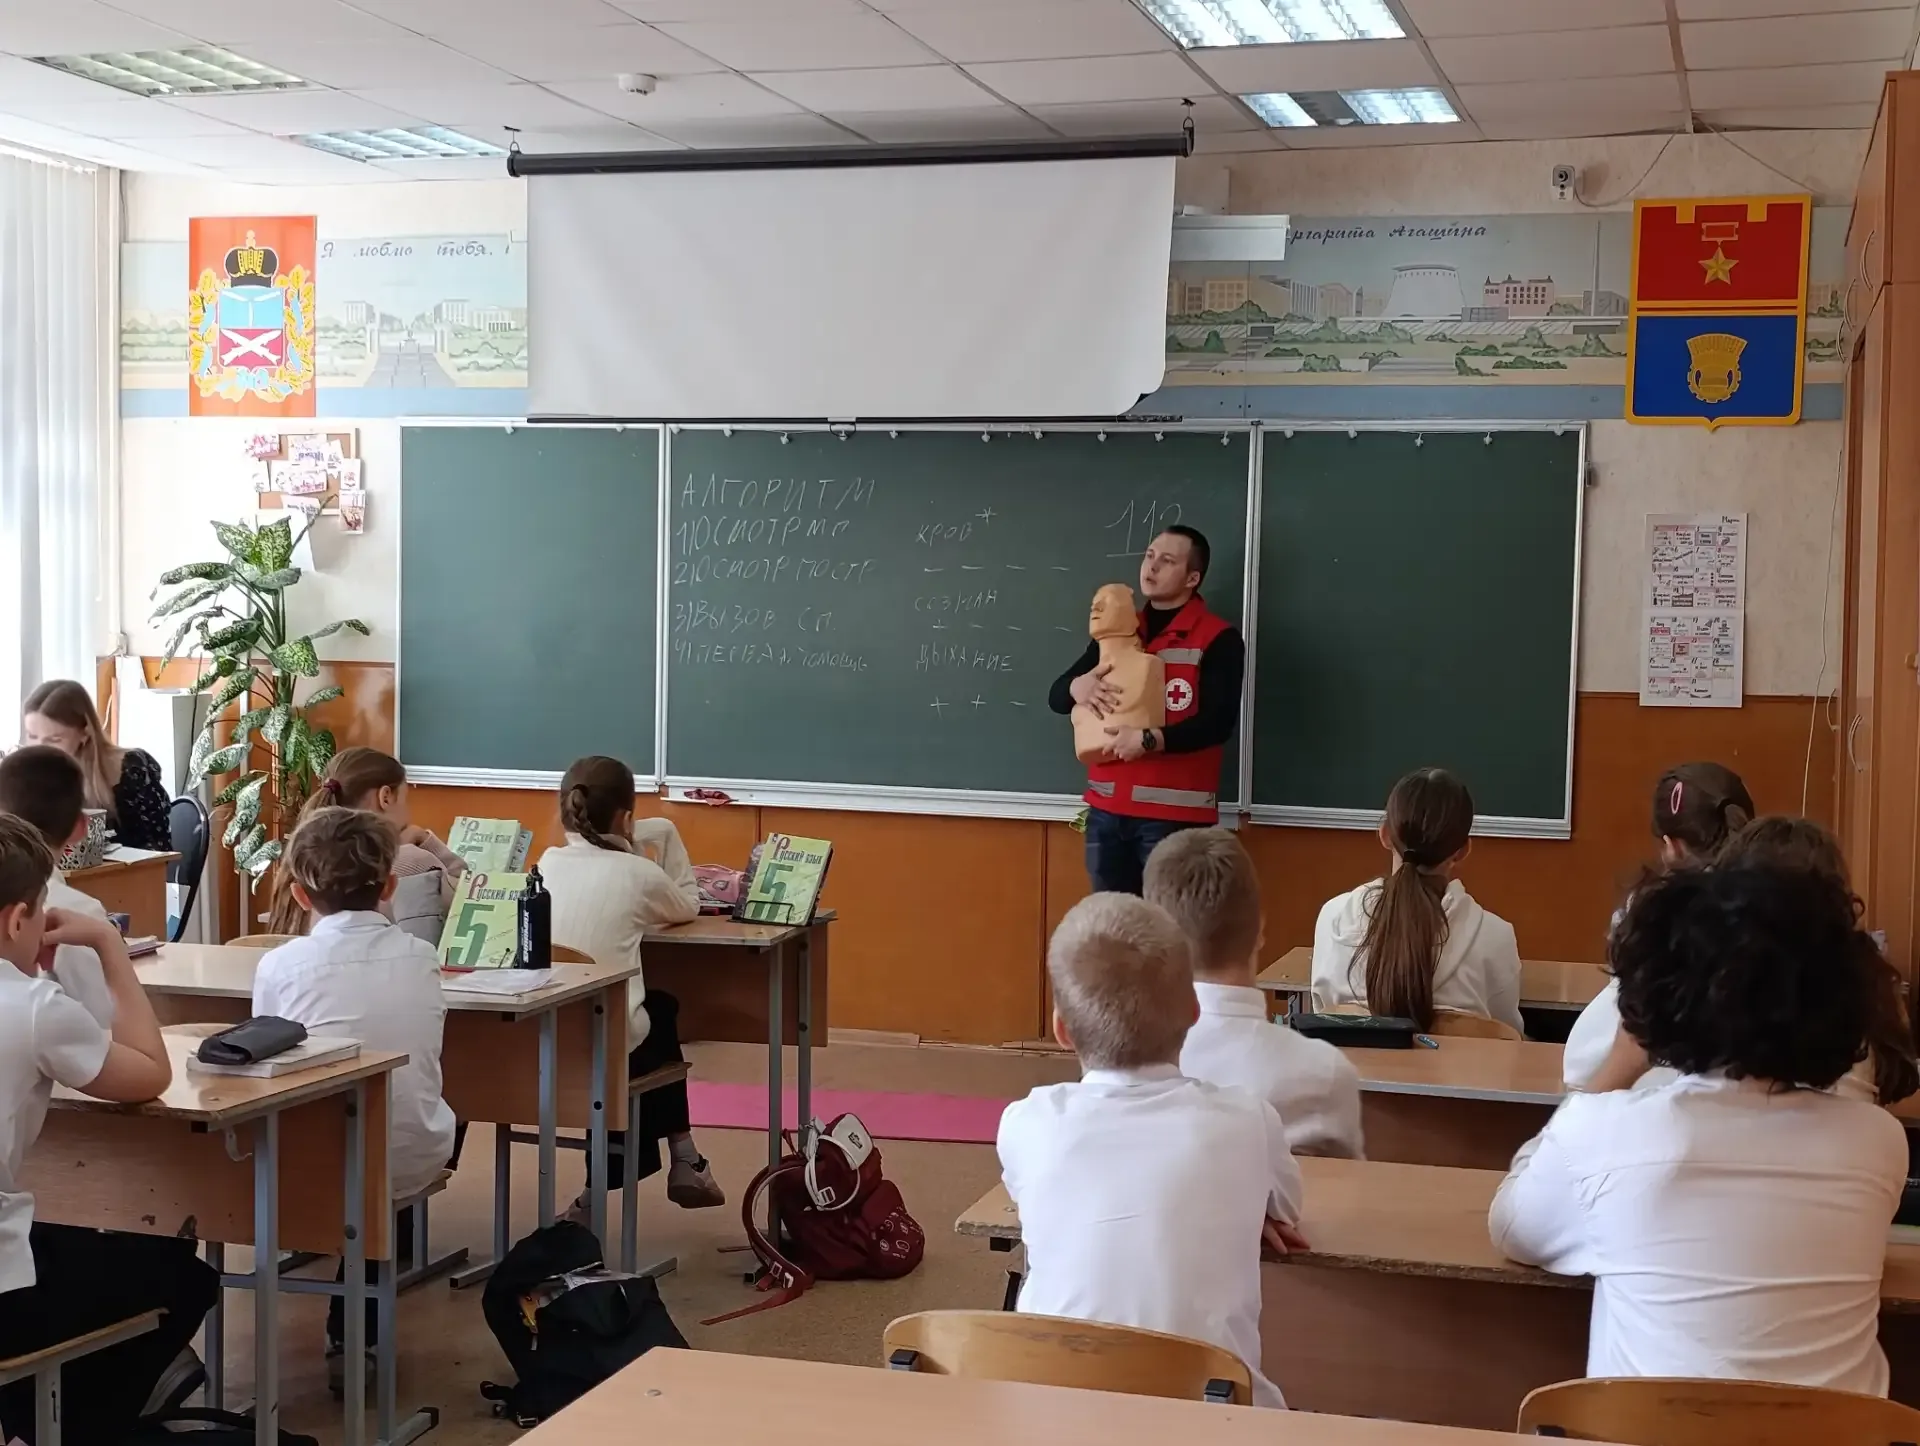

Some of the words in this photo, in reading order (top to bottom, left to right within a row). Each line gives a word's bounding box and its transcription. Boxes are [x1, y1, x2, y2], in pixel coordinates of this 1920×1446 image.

[320, 241, 334, 258] Я
[1286, 226, 1376, 245] ргарита
[681, 473, 875, 512] АЛГОРИТМ
[751, 862, 794, 921] 5
[447, 903, 496, 967] 5
